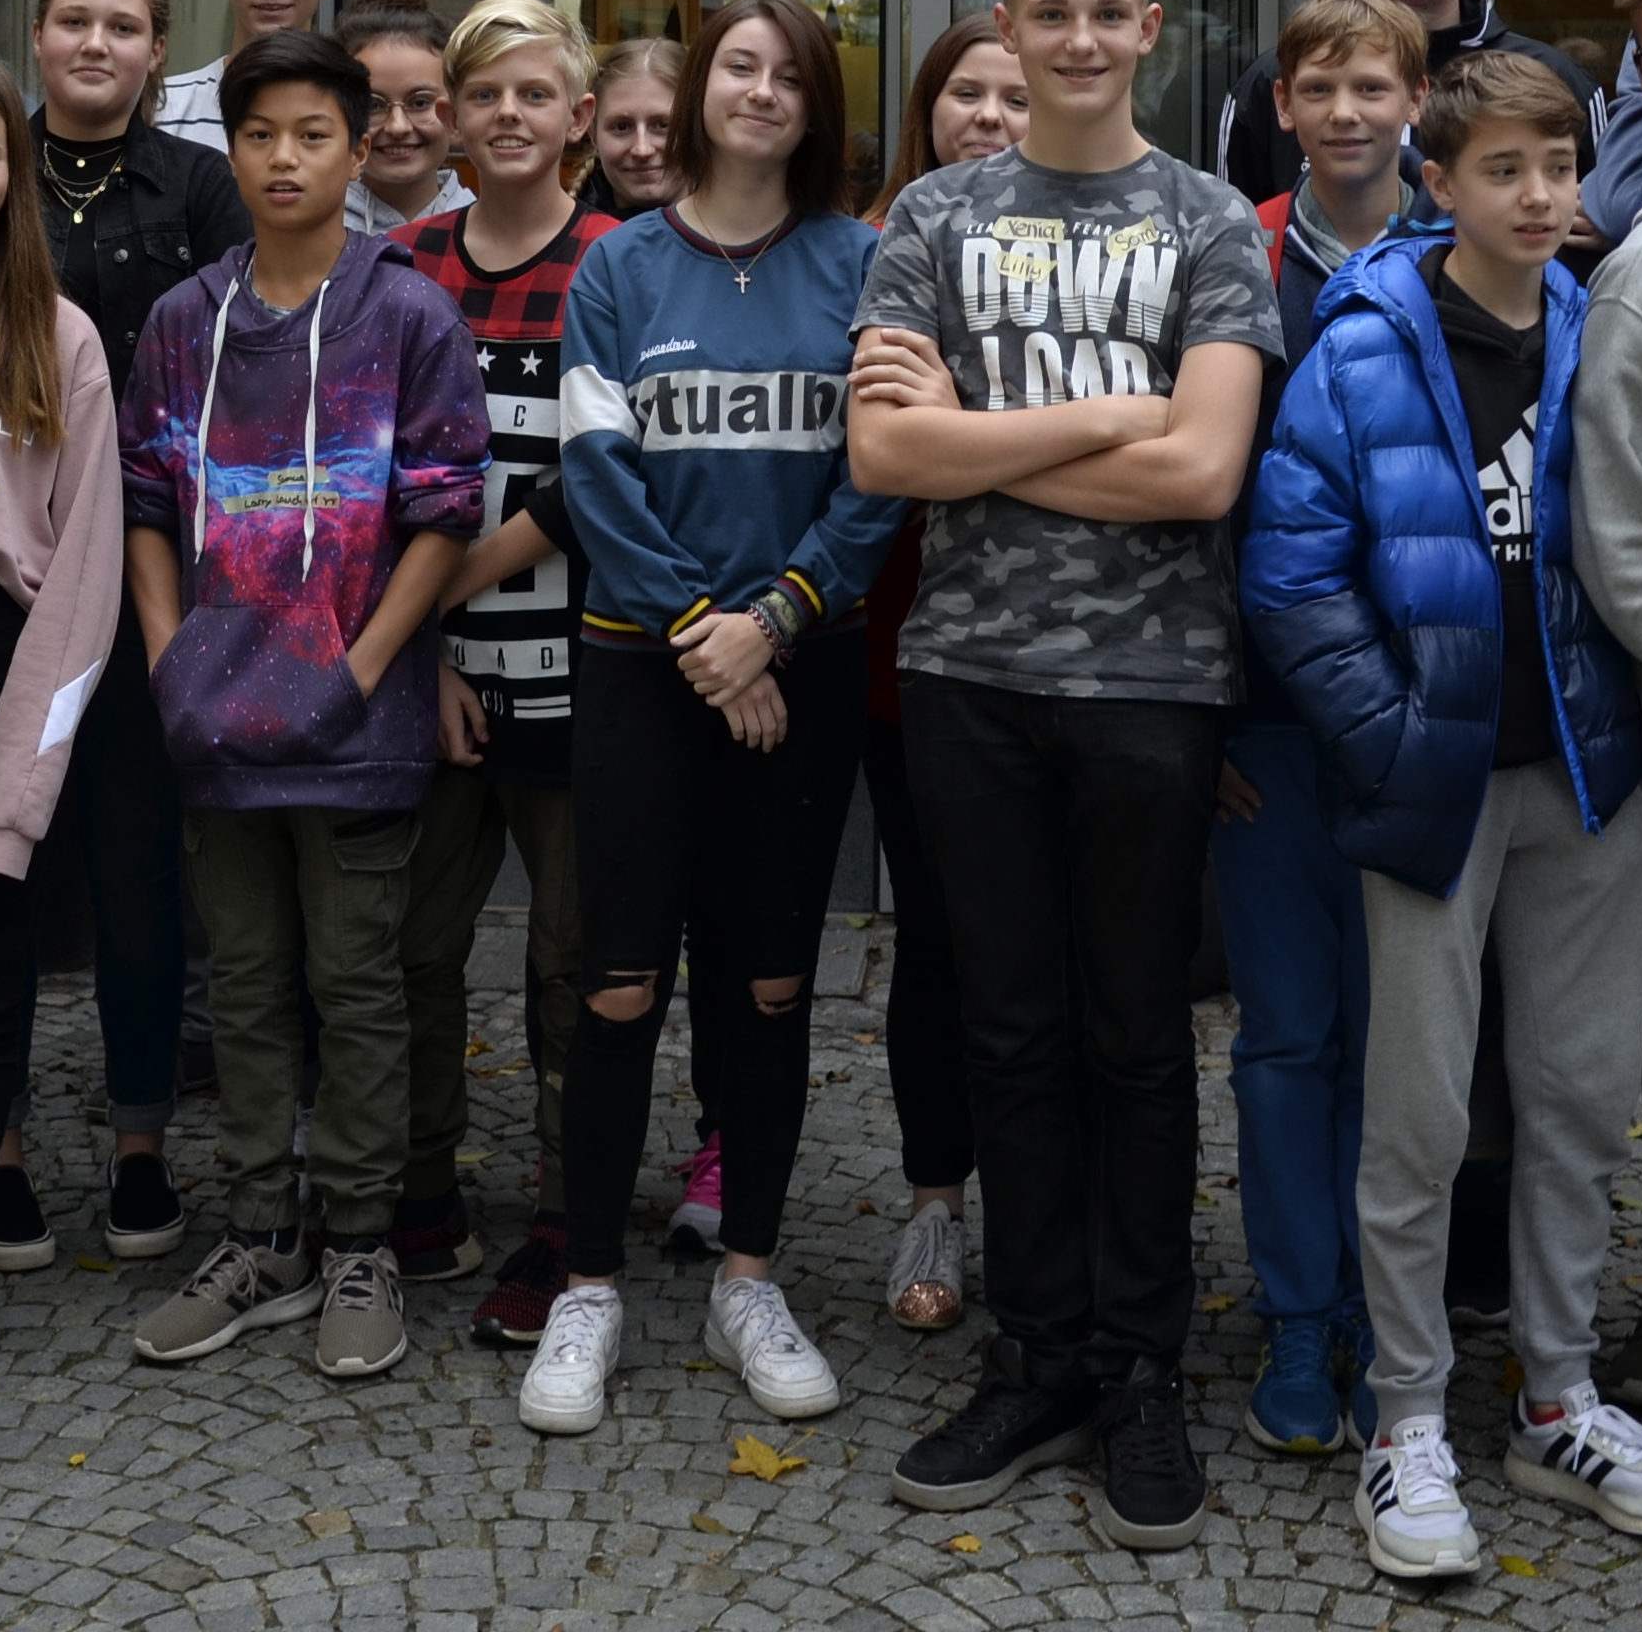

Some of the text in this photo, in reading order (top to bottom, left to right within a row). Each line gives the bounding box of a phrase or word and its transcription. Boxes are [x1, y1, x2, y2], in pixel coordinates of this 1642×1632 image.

[1007, 220, 1057, 241] Xenia
[1072, 222, 1113, 237] FEAR
[999, 254, 1043, 282] Lilly
[961, 236, 1179, 345] DOWN
